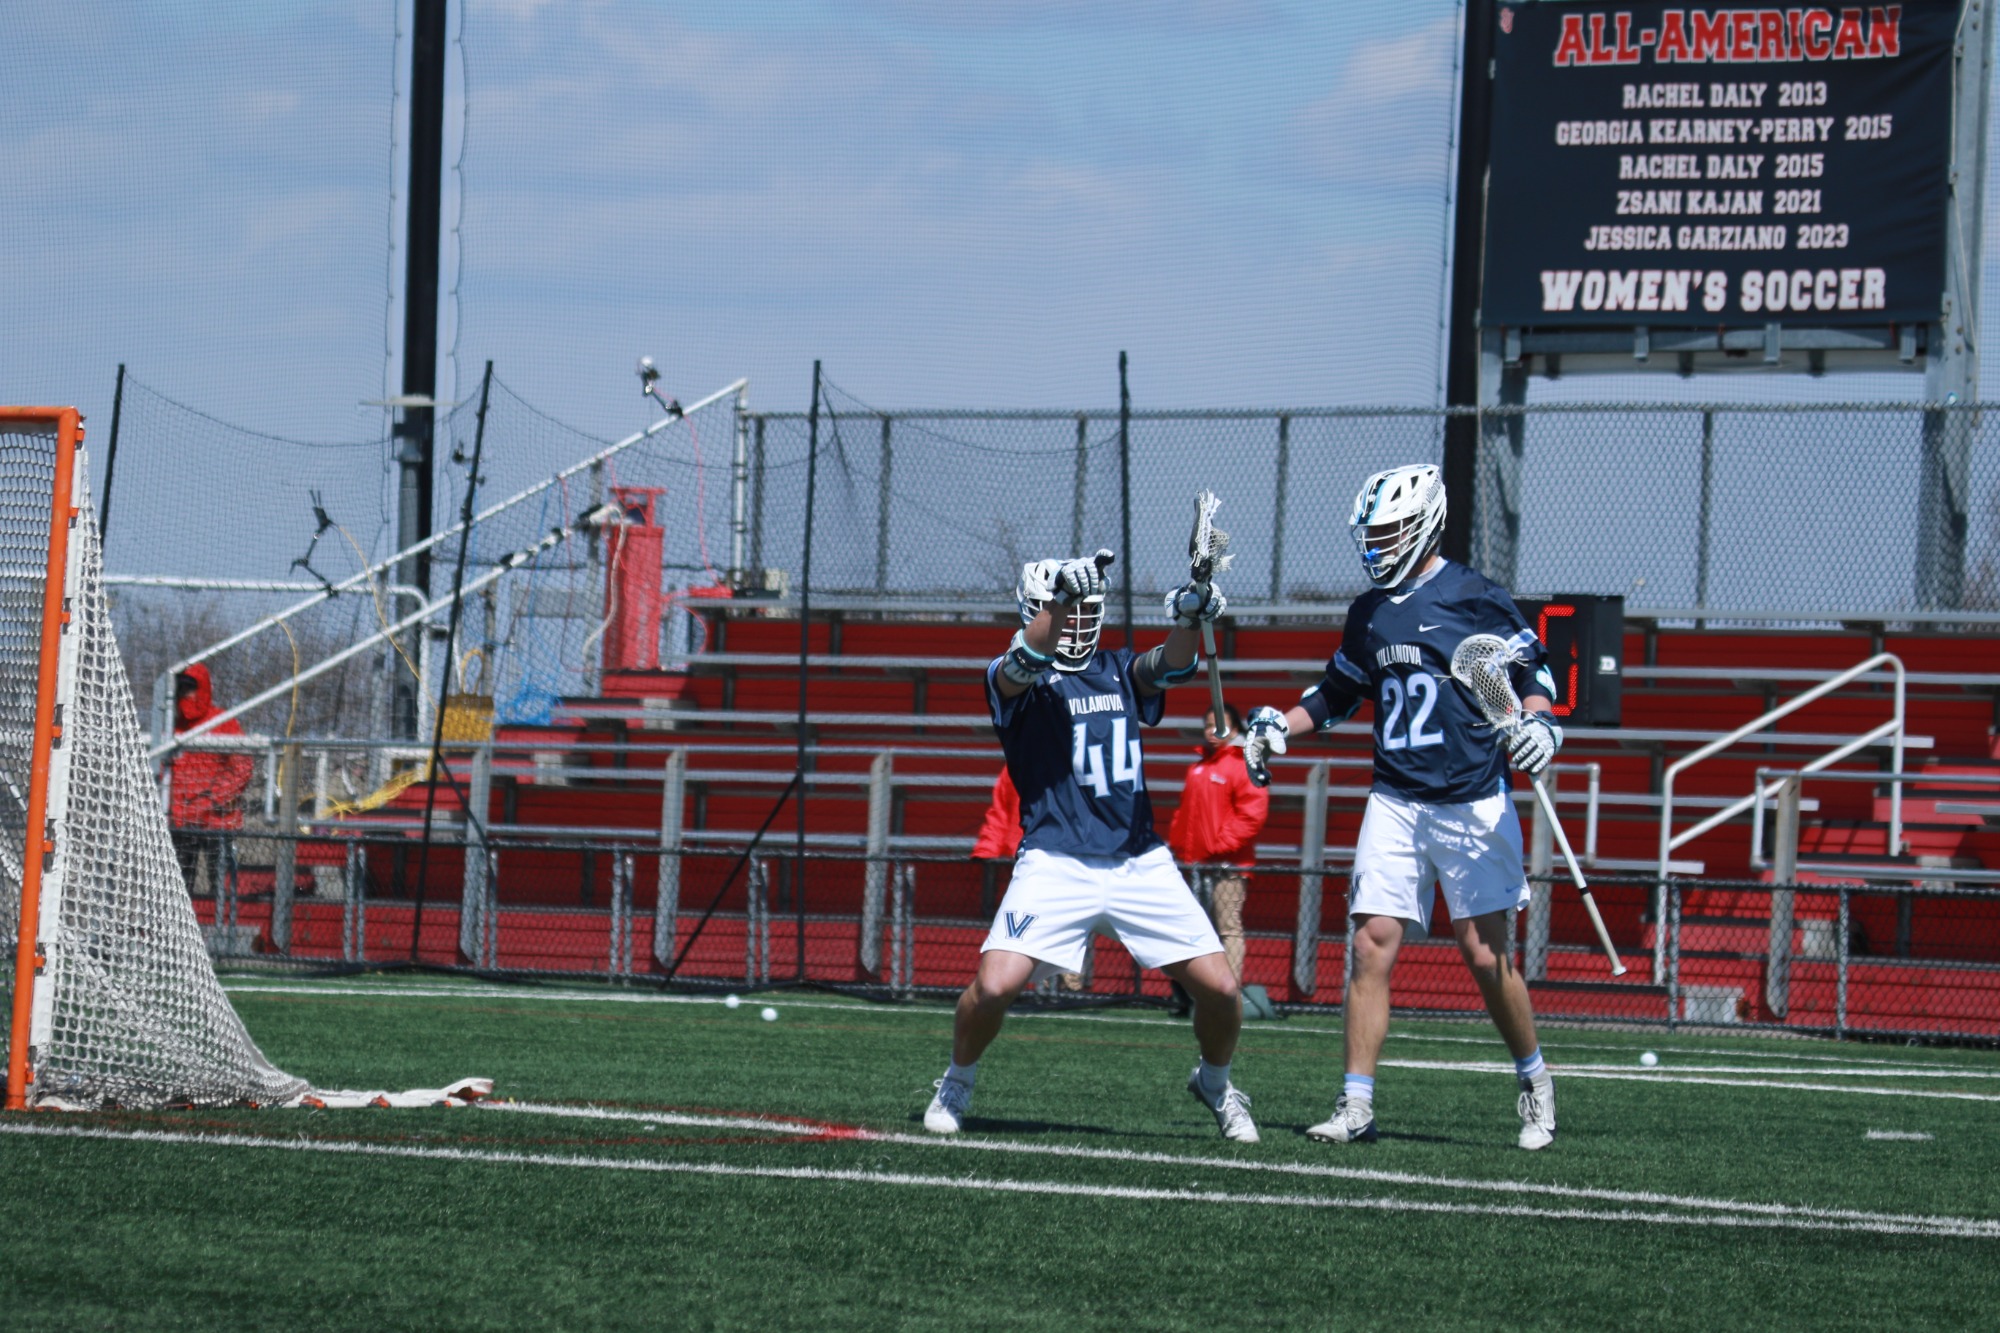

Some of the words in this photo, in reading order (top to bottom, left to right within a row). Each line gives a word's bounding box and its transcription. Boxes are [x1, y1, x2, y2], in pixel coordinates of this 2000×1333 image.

[1553, 6, 1901, 66] ALL-AMERICAN
[1623, 83, 1704, 108] RACHEL
[1710, 83, 1767, 107] DALY
[1779, 81, 1827, 106] 2013
[1556, 120, 1643, 145] GEORGIA
[1649, 117, 1834, 143] KEARNEY-PERRY
[1845, 114, 1892, 140] 2015
[1619, 155, 1701, 179] RACHEL
[1707, 155, 1764, 179] DALY
[1775, 153, 1824, 178] 2015
[1616, 190, 1682, 214] ZSANI
[1686, 190, 1763, 214] KAJAN
[1774, 189, 1821, 214] 2021
[1584, 226, 1672, 250] JESSICA
[1677, 225, 1787, 250] GARZIANO
[1797, 224, 1849, 249] 2023
[1541, 270, 1728, 311] WOMEN'S
[1740, 268, 1886, 311] SOCCER
[1376, 644, 1422, 669] VILLANOVA
[1069, 694, 1124, 716] VILLANOVA
[1382, 672, 1444, 751] 22
[1073, 717, 1144, 798] 44
[1003, 910, 1039, 941] V
